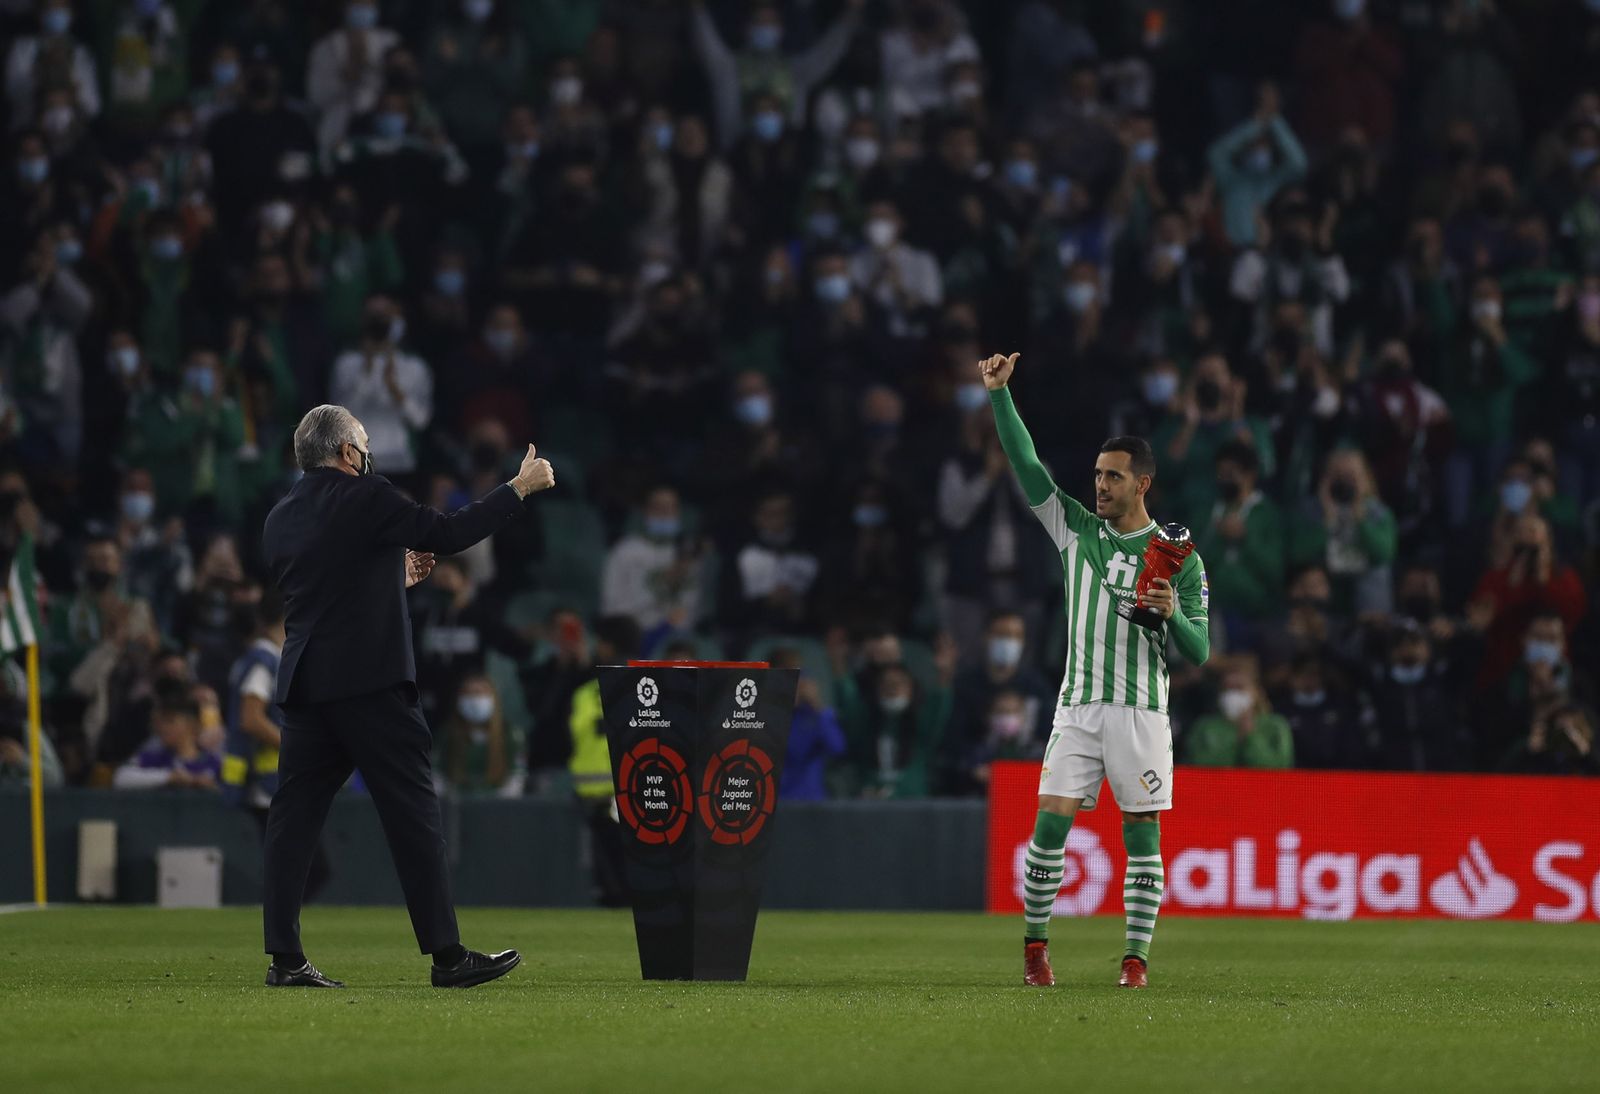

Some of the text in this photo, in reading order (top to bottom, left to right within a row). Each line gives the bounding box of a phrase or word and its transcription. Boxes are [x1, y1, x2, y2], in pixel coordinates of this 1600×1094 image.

[638, 709, 660, 718] LaLiga
[733, 710, 755, 719] LaLiga
[638, 719, 671, 728] Santander
[731, 720, 765, 729] Santander
[646, 776, 663, 784] MVP
[728, 777, 749, 788] Mejor
[643, 788, 666, 797] of the
[722, 790, 753, 799] Jugador
[645, 801, 669, 810] Month
[722, 801, 751, 810] del Mes
[1161, 829, 1600, 923] aLiga S
